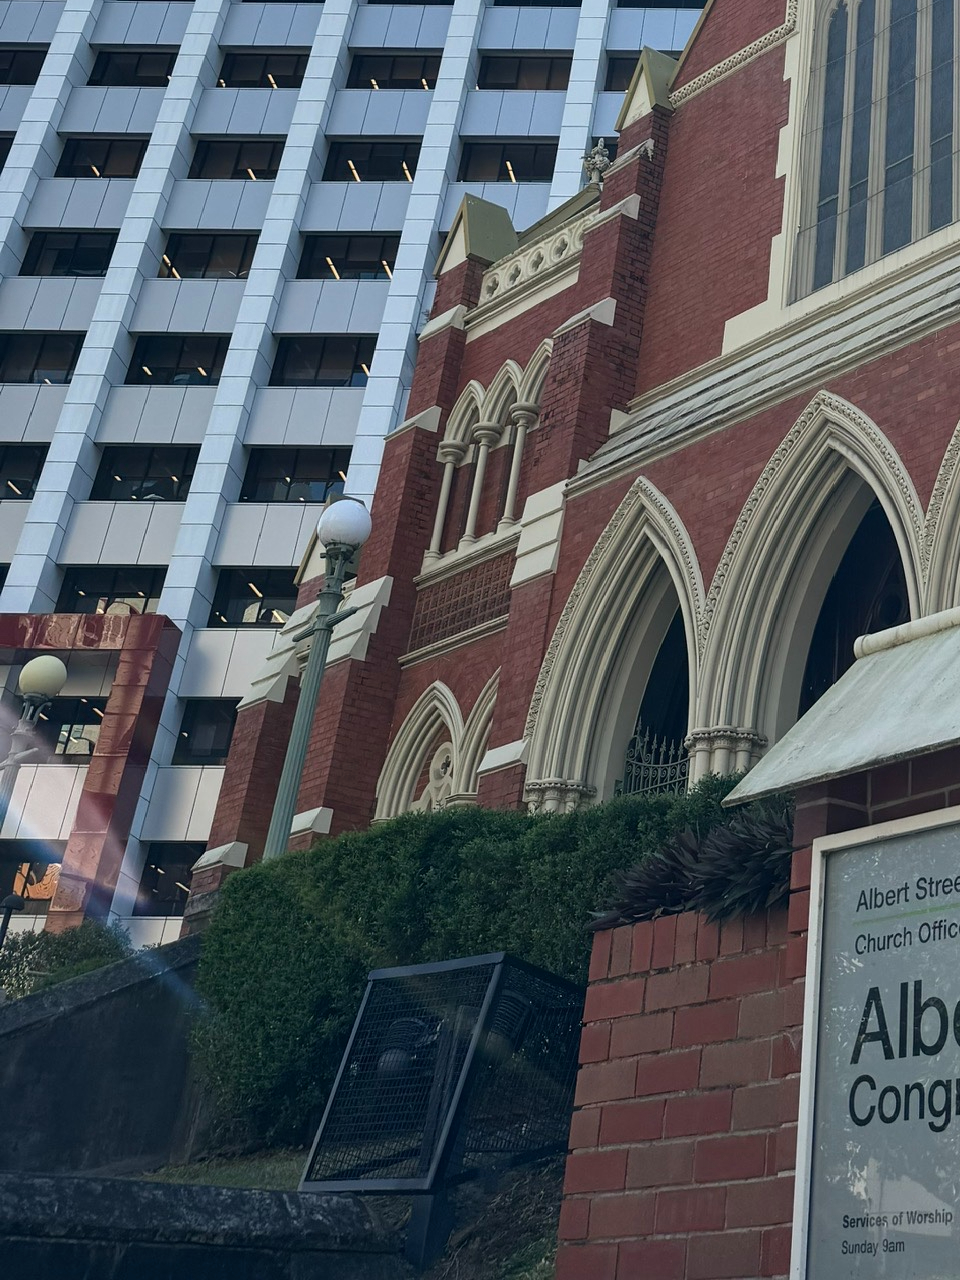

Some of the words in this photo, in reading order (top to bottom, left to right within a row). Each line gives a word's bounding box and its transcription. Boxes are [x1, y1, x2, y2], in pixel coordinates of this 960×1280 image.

[856, 882, 910, 912] Albert
[855, 929, 912, 955] Church
[842, 1213, 888, 1229] Services
[892, 1211, 904, 1226] of
[906, 1208, 953, 1226] Worship
[841, 1240, 879, 1257] Sunday
[882, 1238, 905, 1253] 9am
